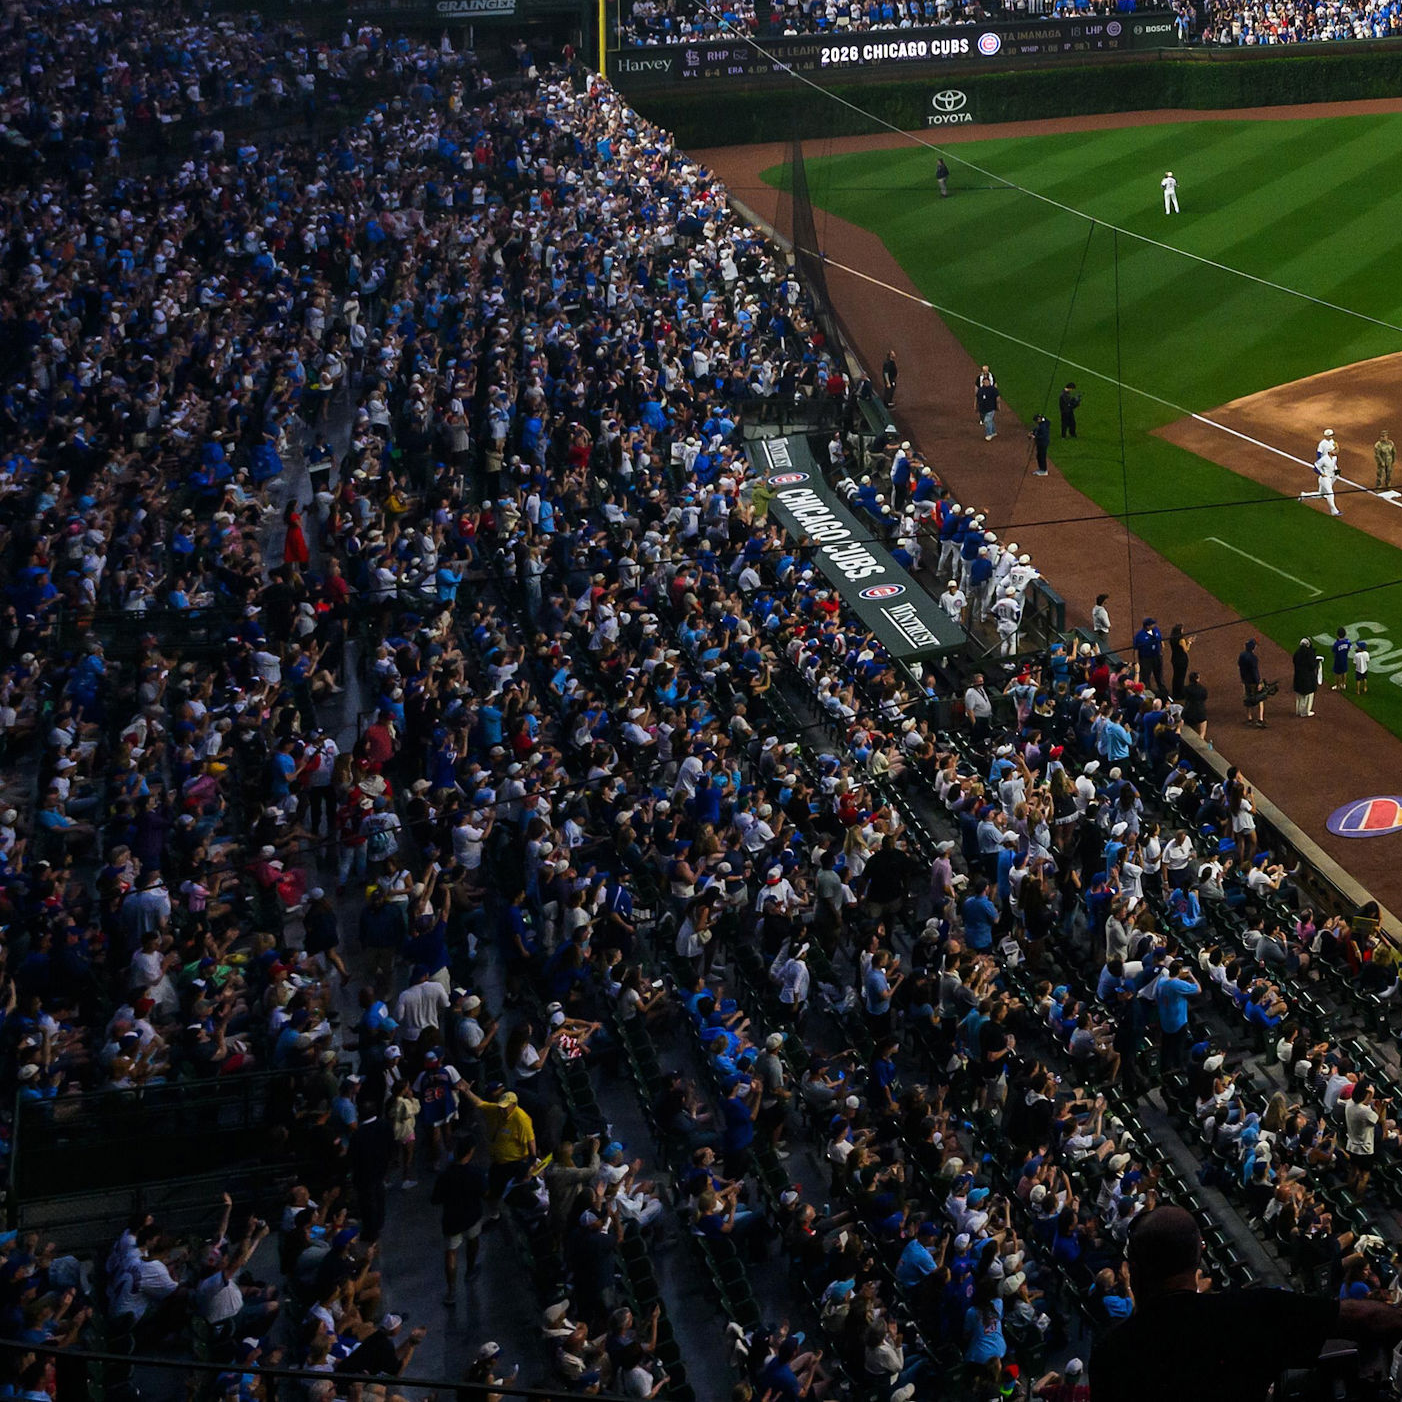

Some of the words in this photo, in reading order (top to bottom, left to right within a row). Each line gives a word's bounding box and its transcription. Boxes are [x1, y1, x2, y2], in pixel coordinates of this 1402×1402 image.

[436, 0, 517, 11] GRAINGER
[1146, 24, 1172, 33] BOSCH
[707, 50, 728, 61] RHP
[821, 47, 858, 64] 2026
[863, 41, 927, 60] CHICAGO
[931, 38, 969, 56] CUBS
[618, 59, 672, 75] Harvey
[927, 111, 973, 125] TOYOTA
[776, 488, 851, 543] CHICAGO
[821, 540, 886, 582] CUBS
[888, 603, 940, 646] WINTRUST
